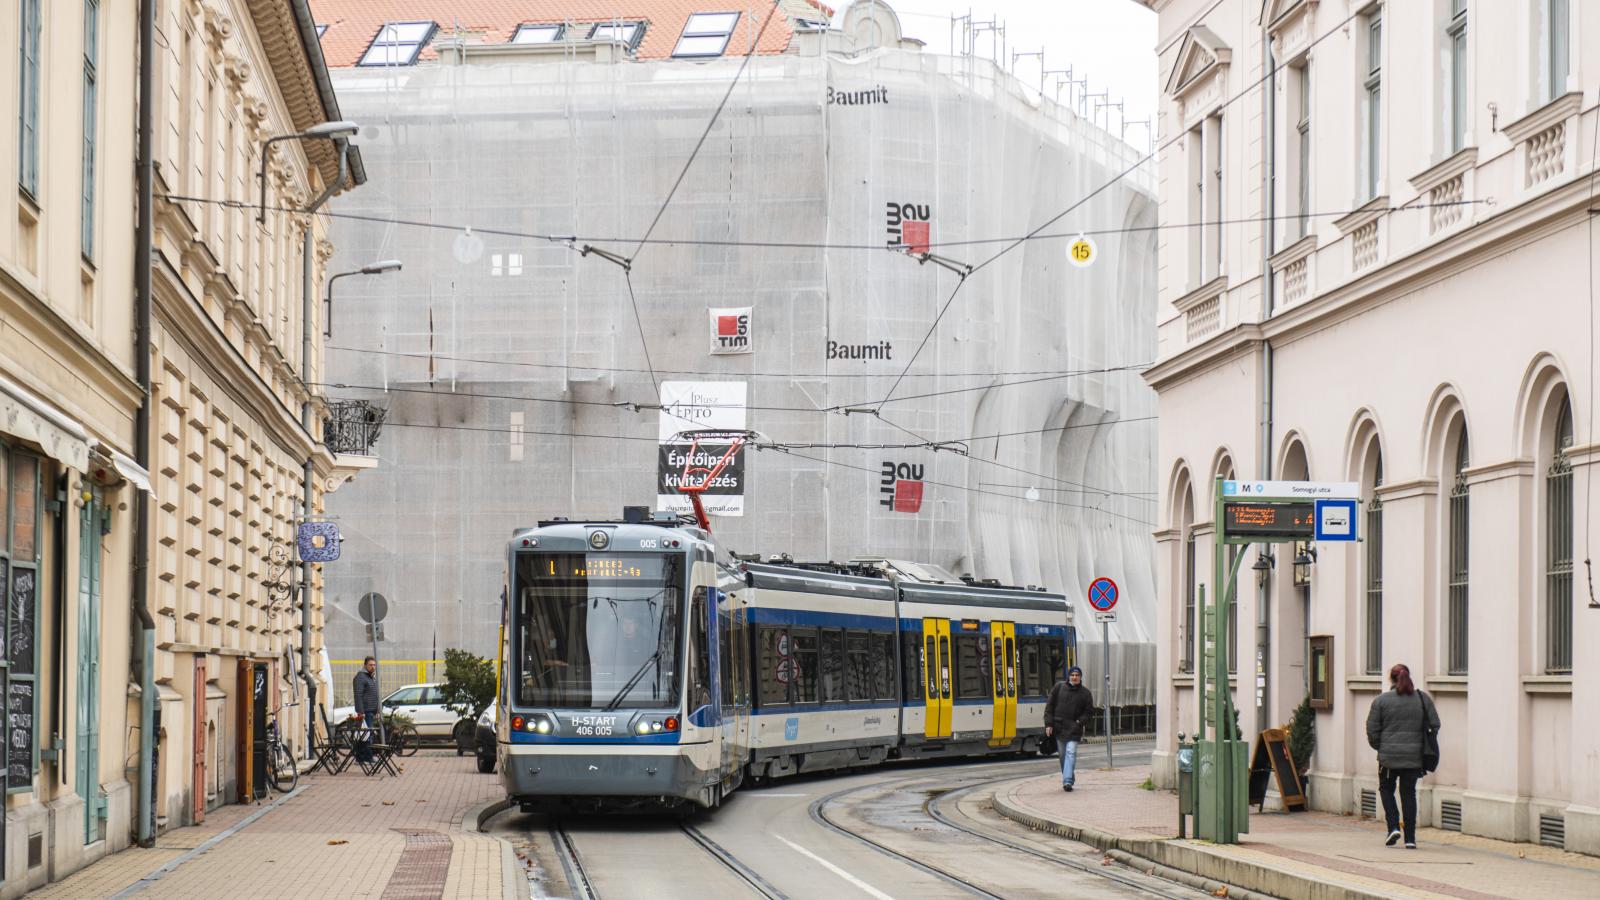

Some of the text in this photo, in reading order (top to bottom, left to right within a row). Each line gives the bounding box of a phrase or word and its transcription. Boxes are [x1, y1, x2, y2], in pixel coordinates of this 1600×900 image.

[827, 84, 889, 105] Baumit
[1073, 244, 1090, 259] 15
[827, 341, 892, 360] Baumit
[668, 450, 735, 469] Építőipari
[665, 473, 738, 487] kivitelezés
[1242, 484, 1251, 492] M
[640, 539, 657, 548] 005
[571, 715, 616, 726] H-START
[576, 726, 612, 736] 406 005
